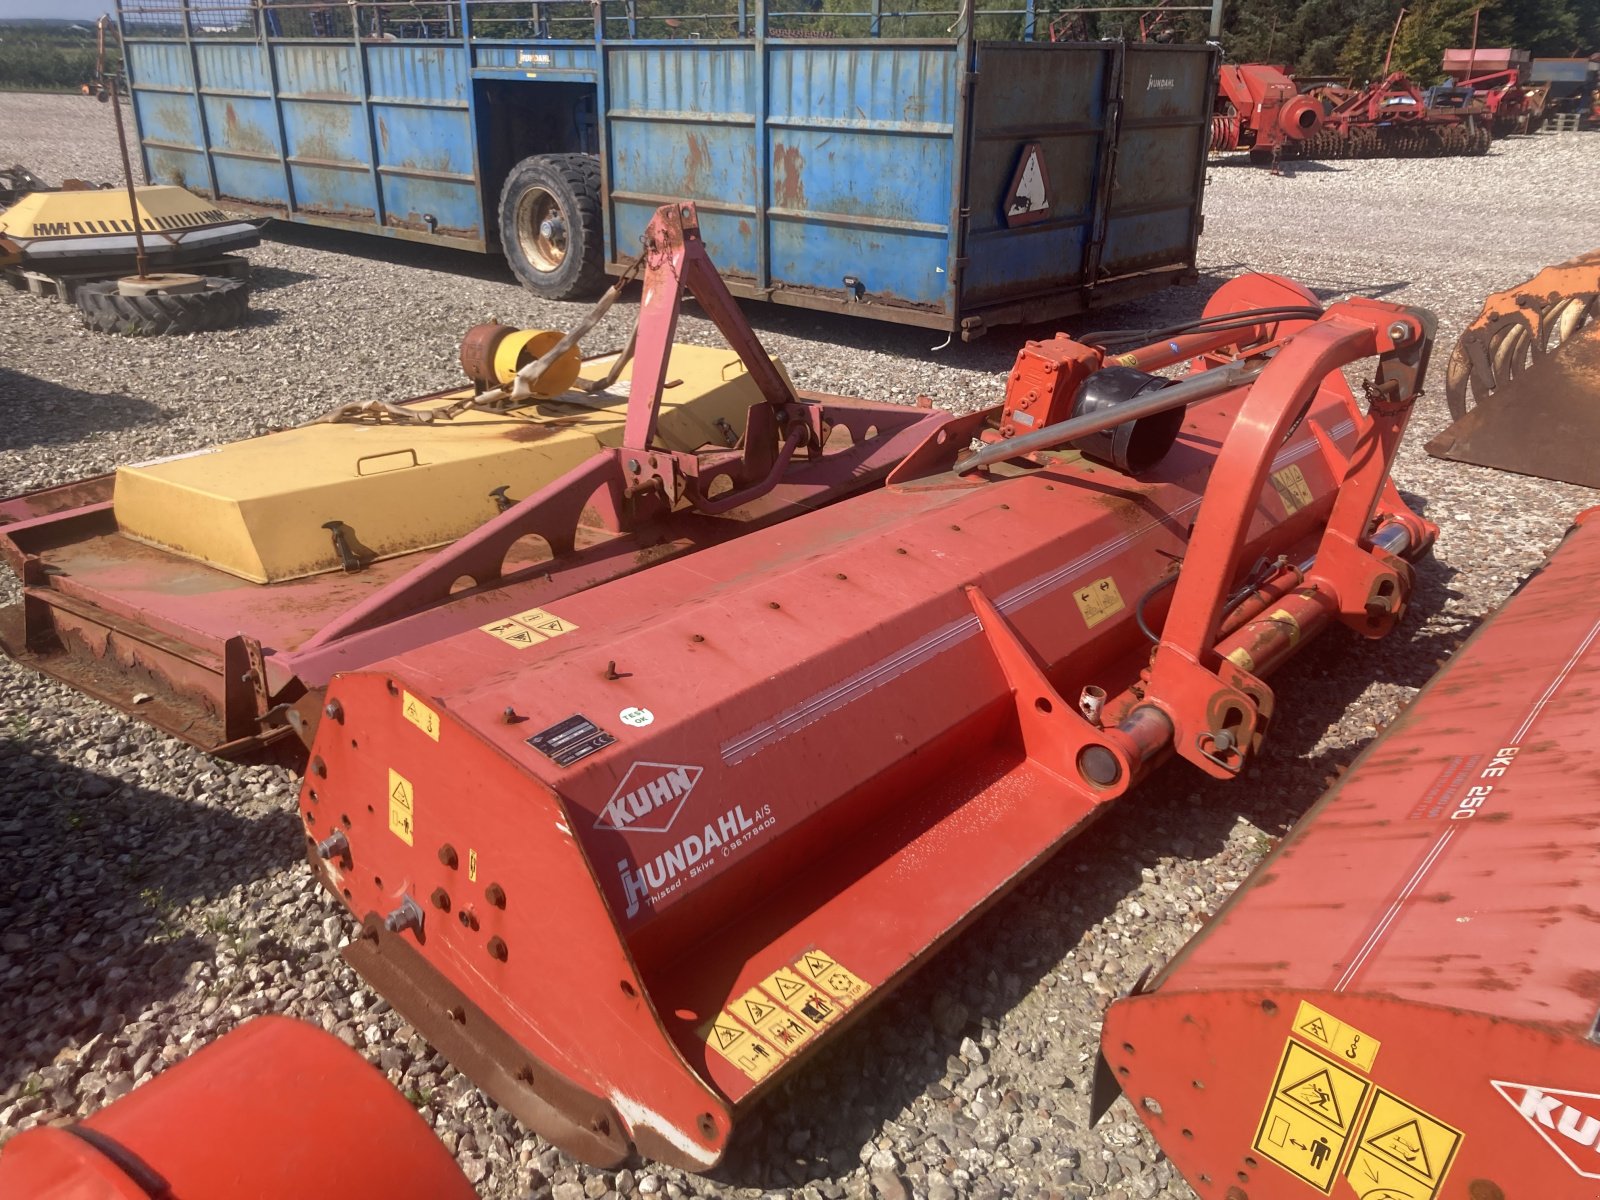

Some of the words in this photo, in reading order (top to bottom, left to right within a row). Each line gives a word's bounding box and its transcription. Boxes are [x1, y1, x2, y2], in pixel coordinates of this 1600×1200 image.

[33, 223, 71, 236] HWH
[202, 209, 227, 223] HWH
[634, 716, 648, 724] OK
[1481, 747, 1520, 778] BKE
[607, 766, 692, 829] KUHN
[755, 804, 771, 822] A/S
[1451, 785, 1493, 819] 250
[646, 879, 681, 906] Thisted
[690, 858, 714, 878] Skive
[1520, 1087, 1600, 1154] KU
